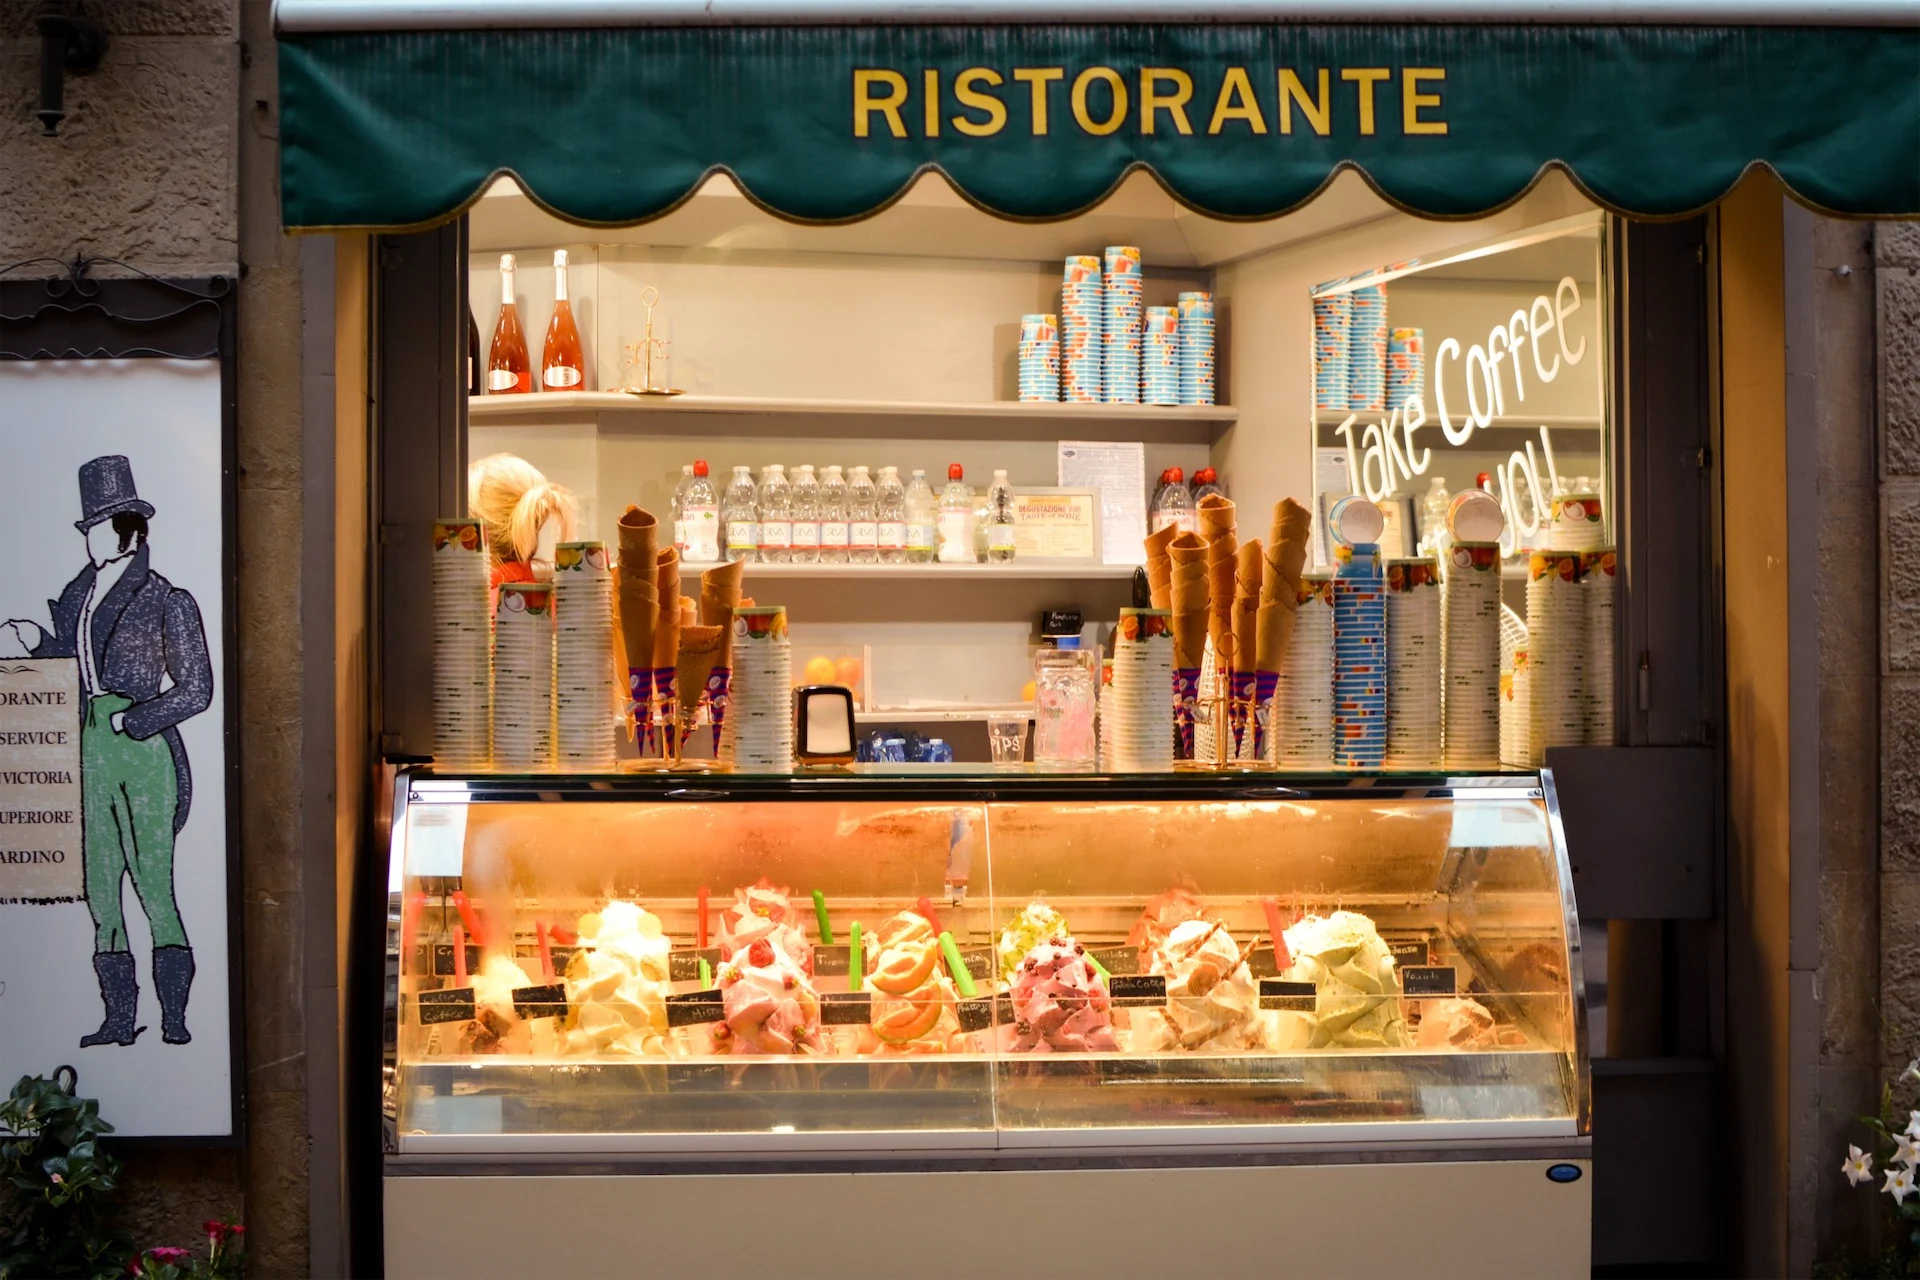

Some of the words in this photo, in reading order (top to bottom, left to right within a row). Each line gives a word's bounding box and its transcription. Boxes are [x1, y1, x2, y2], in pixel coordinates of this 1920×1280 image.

[852, 66, 1449, 138] RISTORANTE
[1334, 394, 1431, 503] Take
[1434, 275, 1587, 447] Coffee
[0, 731, 68, 746] SERVICE
